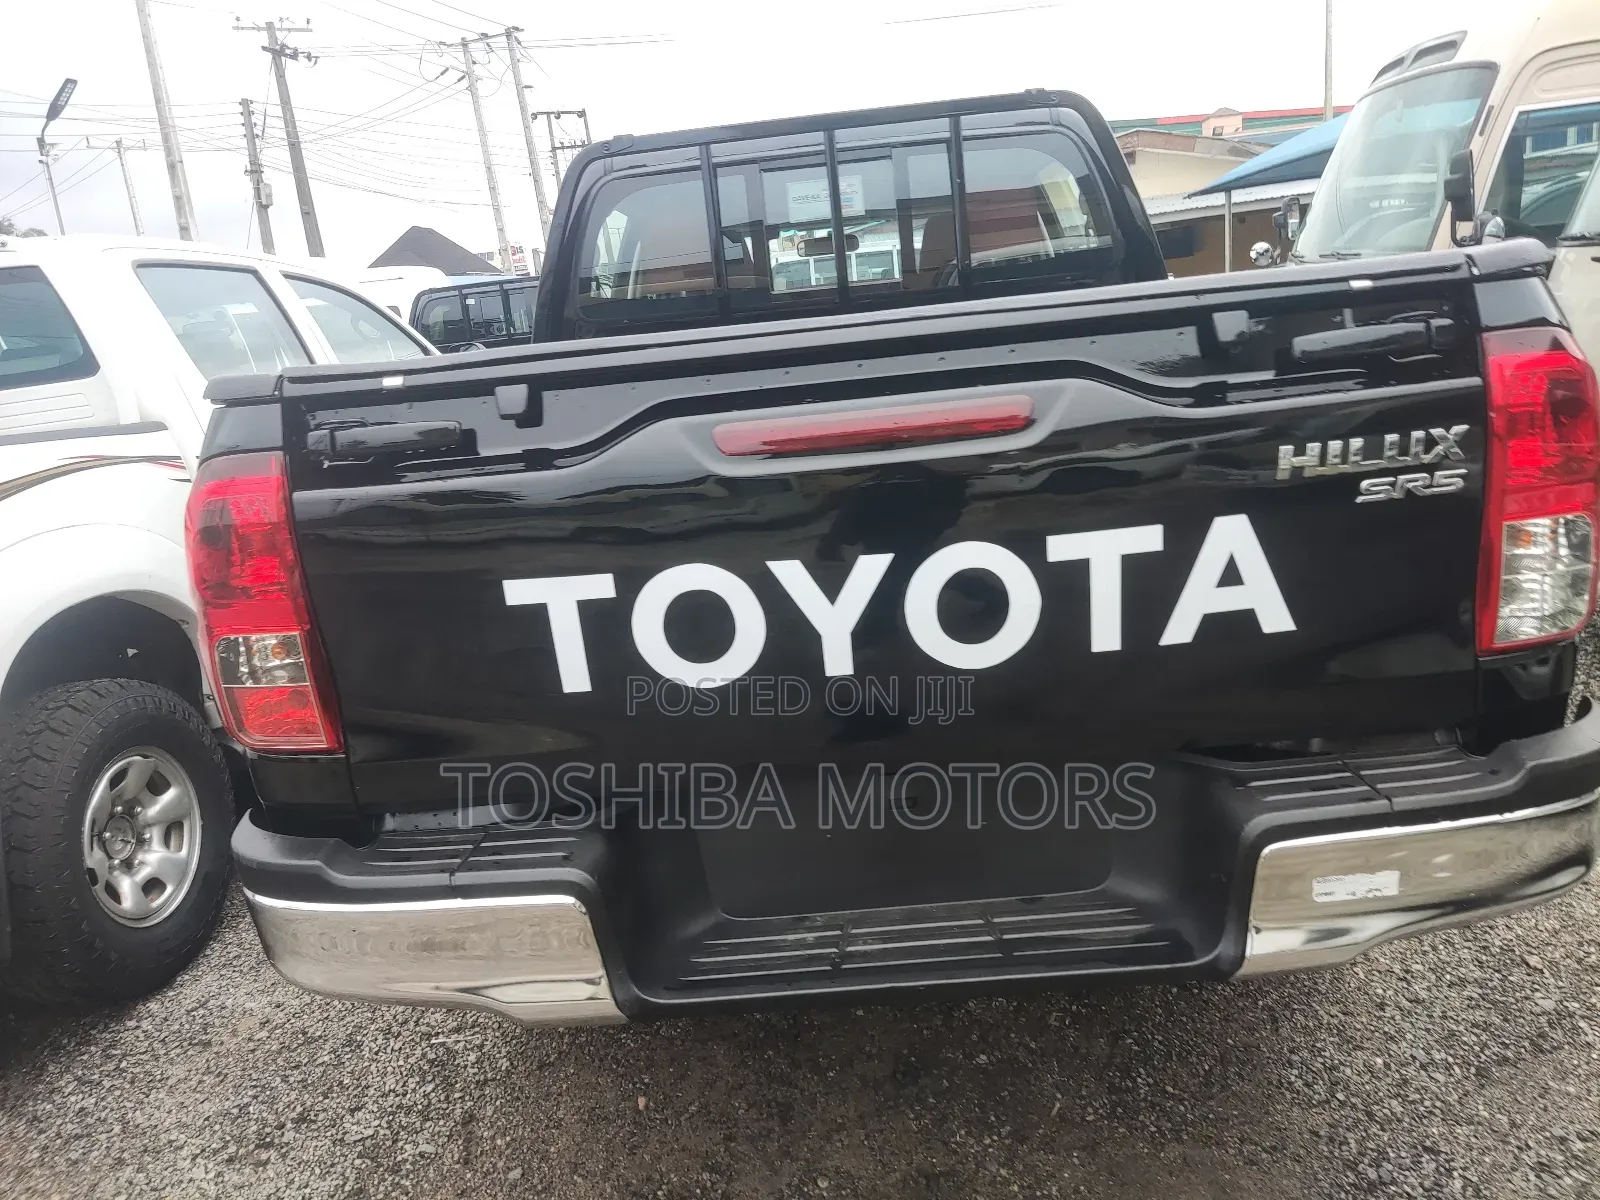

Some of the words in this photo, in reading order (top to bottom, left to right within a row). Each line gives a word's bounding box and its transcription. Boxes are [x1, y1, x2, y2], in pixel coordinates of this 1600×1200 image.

[1275, 424, 1470, 480] HILUX
[1355, 468, 1469, 504] SR5
[503, 514, 1296, 693] TOYOTA
